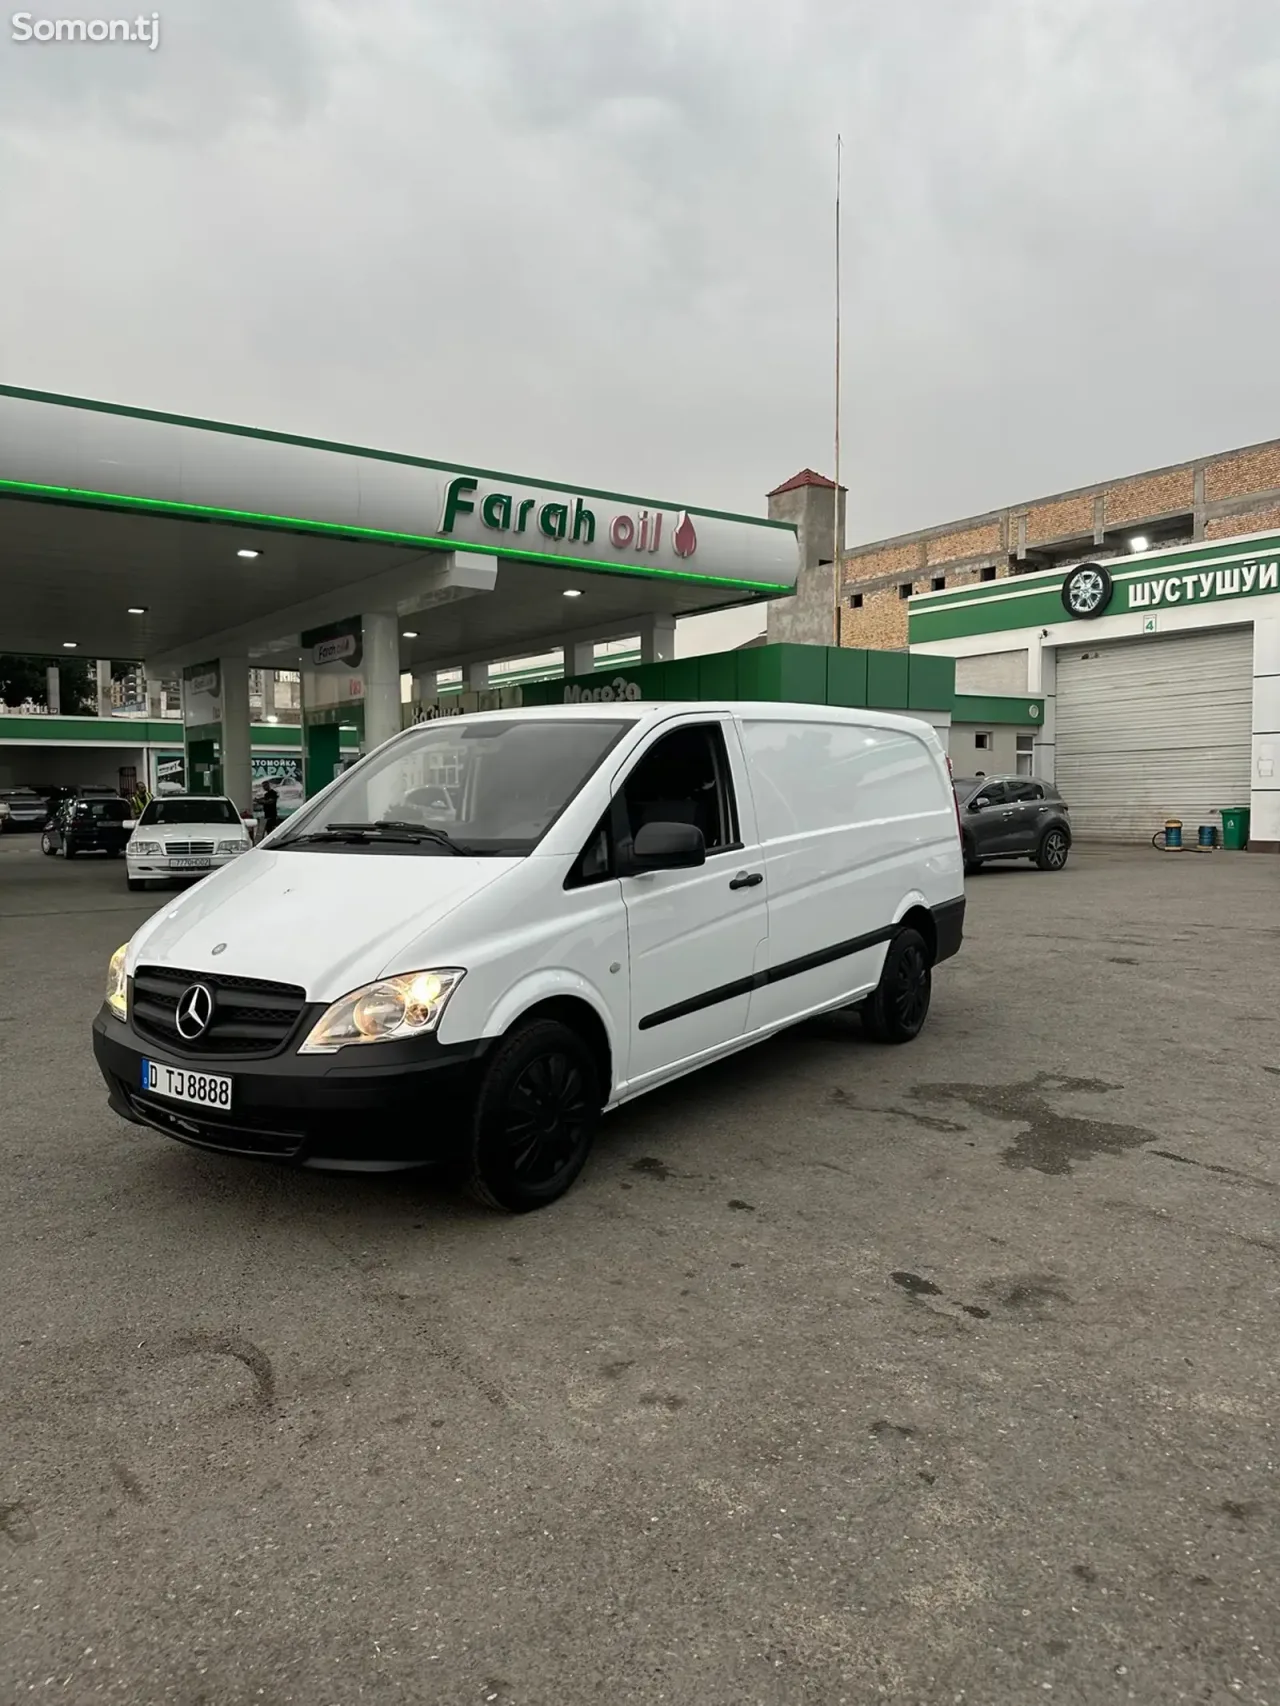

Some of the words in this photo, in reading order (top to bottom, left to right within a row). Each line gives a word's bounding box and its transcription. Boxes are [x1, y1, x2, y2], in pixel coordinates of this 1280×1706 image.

[437, 476, 596, 544] Farah
[609, 510, 663, 552] oil
[1145, 620, 1154, 631] 4
[251, 759, 297, 767] ВТОМОЙКА
[150, 1064, 158, 1088] D
[166, 1069, 229, 1105] TJ8888
